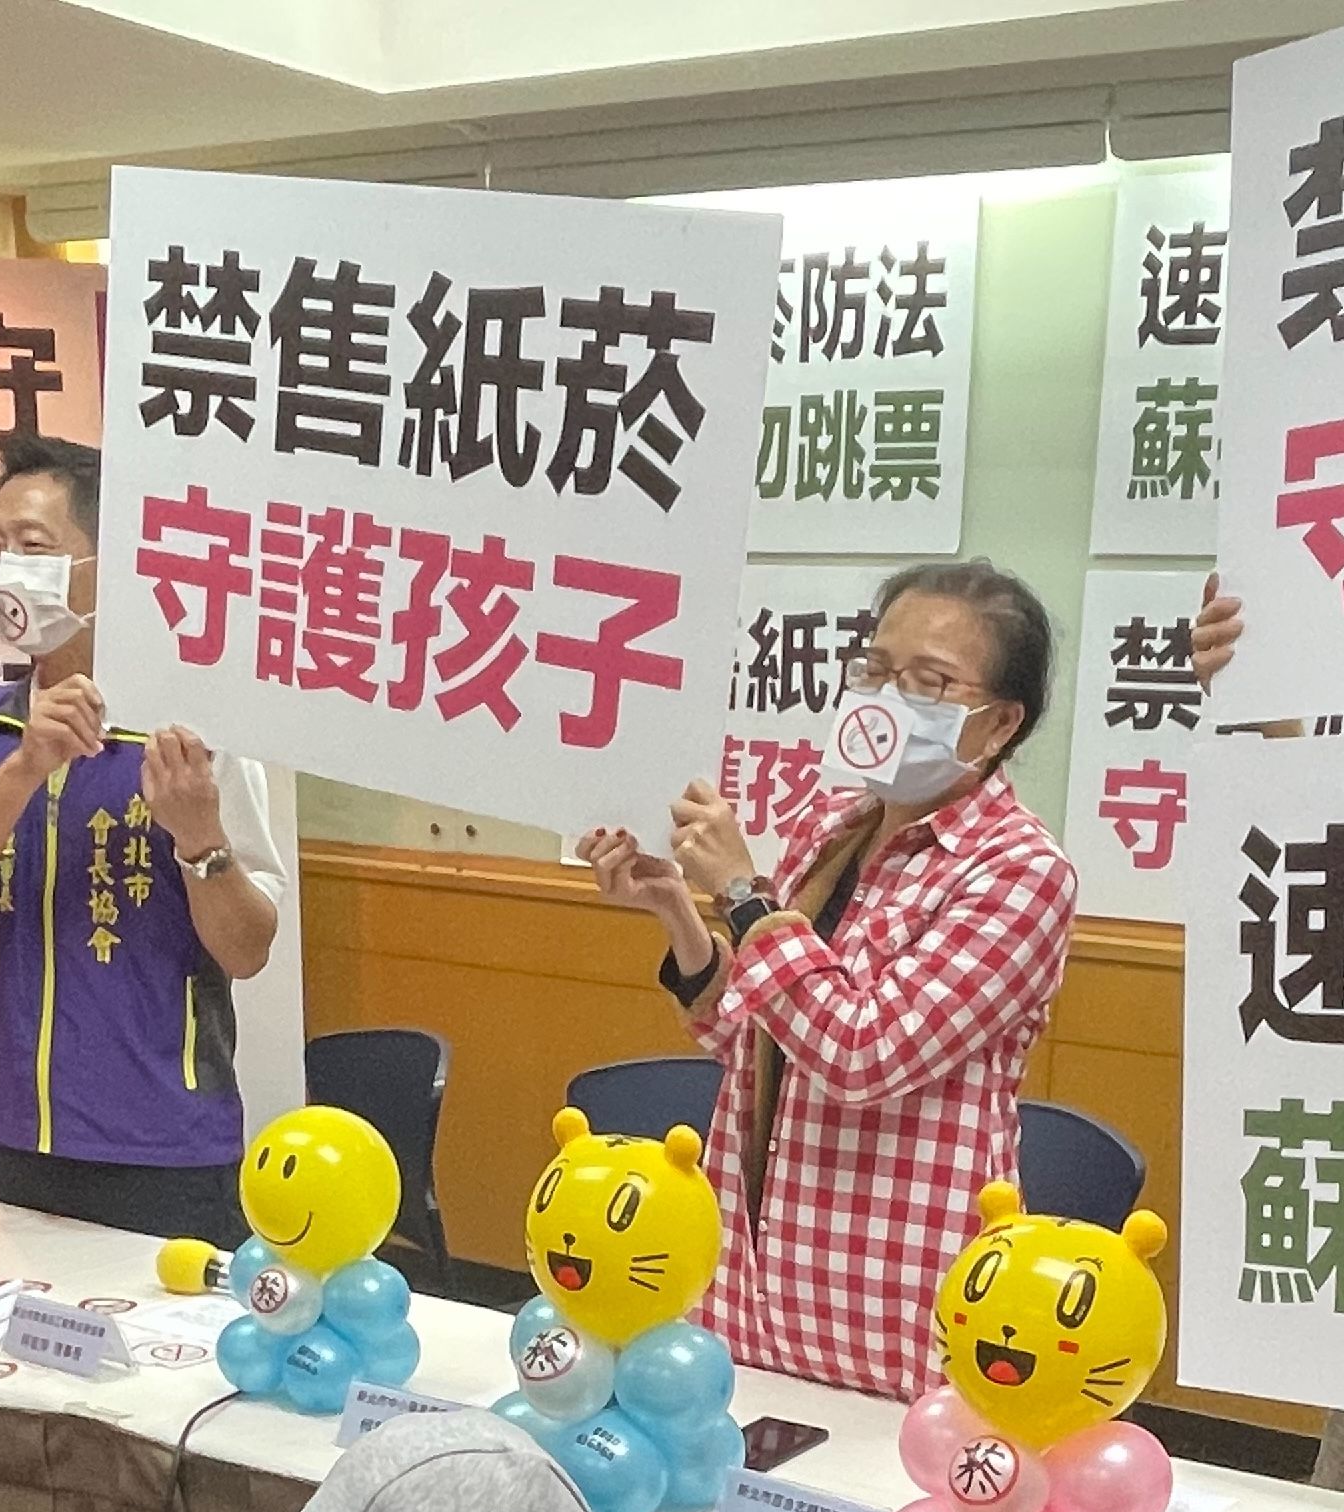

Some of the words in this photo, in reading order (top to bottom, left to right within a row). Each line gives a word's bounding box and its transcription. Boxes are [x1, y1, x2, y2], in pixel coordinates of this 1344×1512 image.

[770, 240, 947, 363] 防法
[1138, 221, 1227, 349] 速
[137, 245, 717, 513] 禁售紙菸
[136, 485, 684, 750] 守護孩子
[1105, 616, 1203, 731] 禁
[1098, 759, 1188, 870] 守
